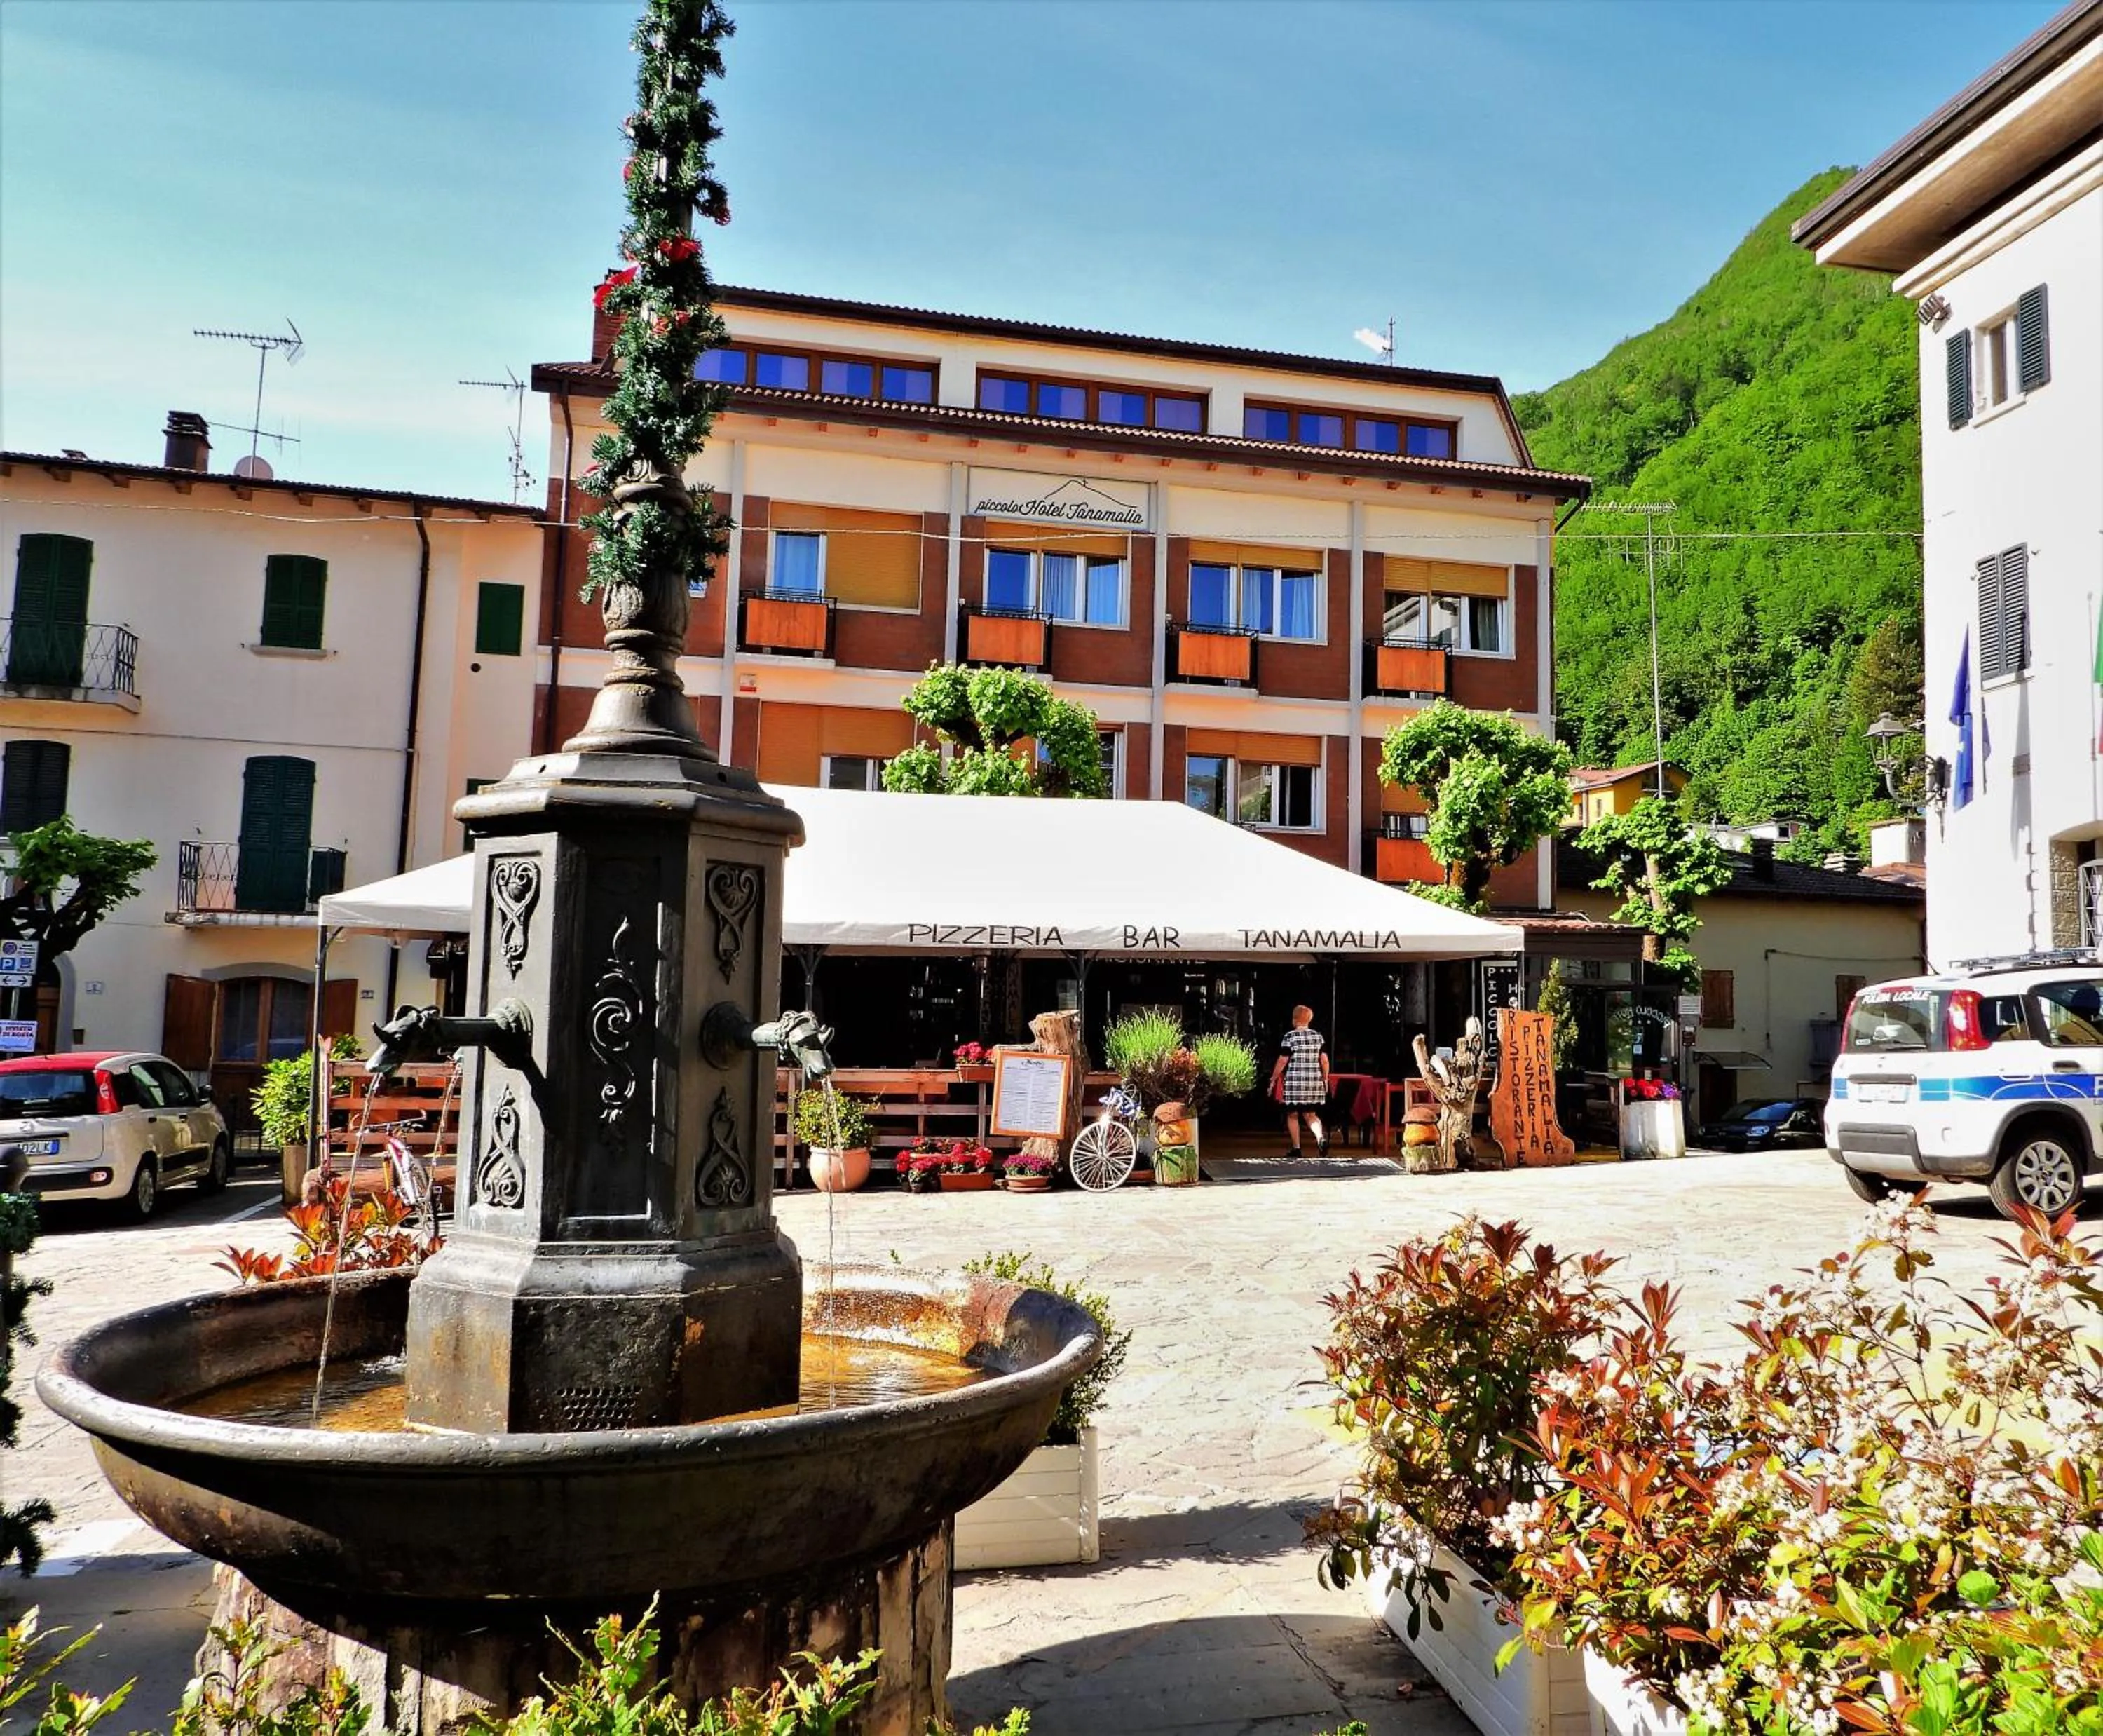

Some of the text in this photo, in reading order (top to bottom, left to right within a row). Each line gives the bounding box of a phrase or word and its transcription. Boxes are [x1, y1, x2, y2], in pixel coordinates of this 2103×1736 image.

[974, 499, 1143, 524] piccolo Hotel Tanamalia
[908, 923, 1401, 949] PIZZERIA BAR TANAMALIA
